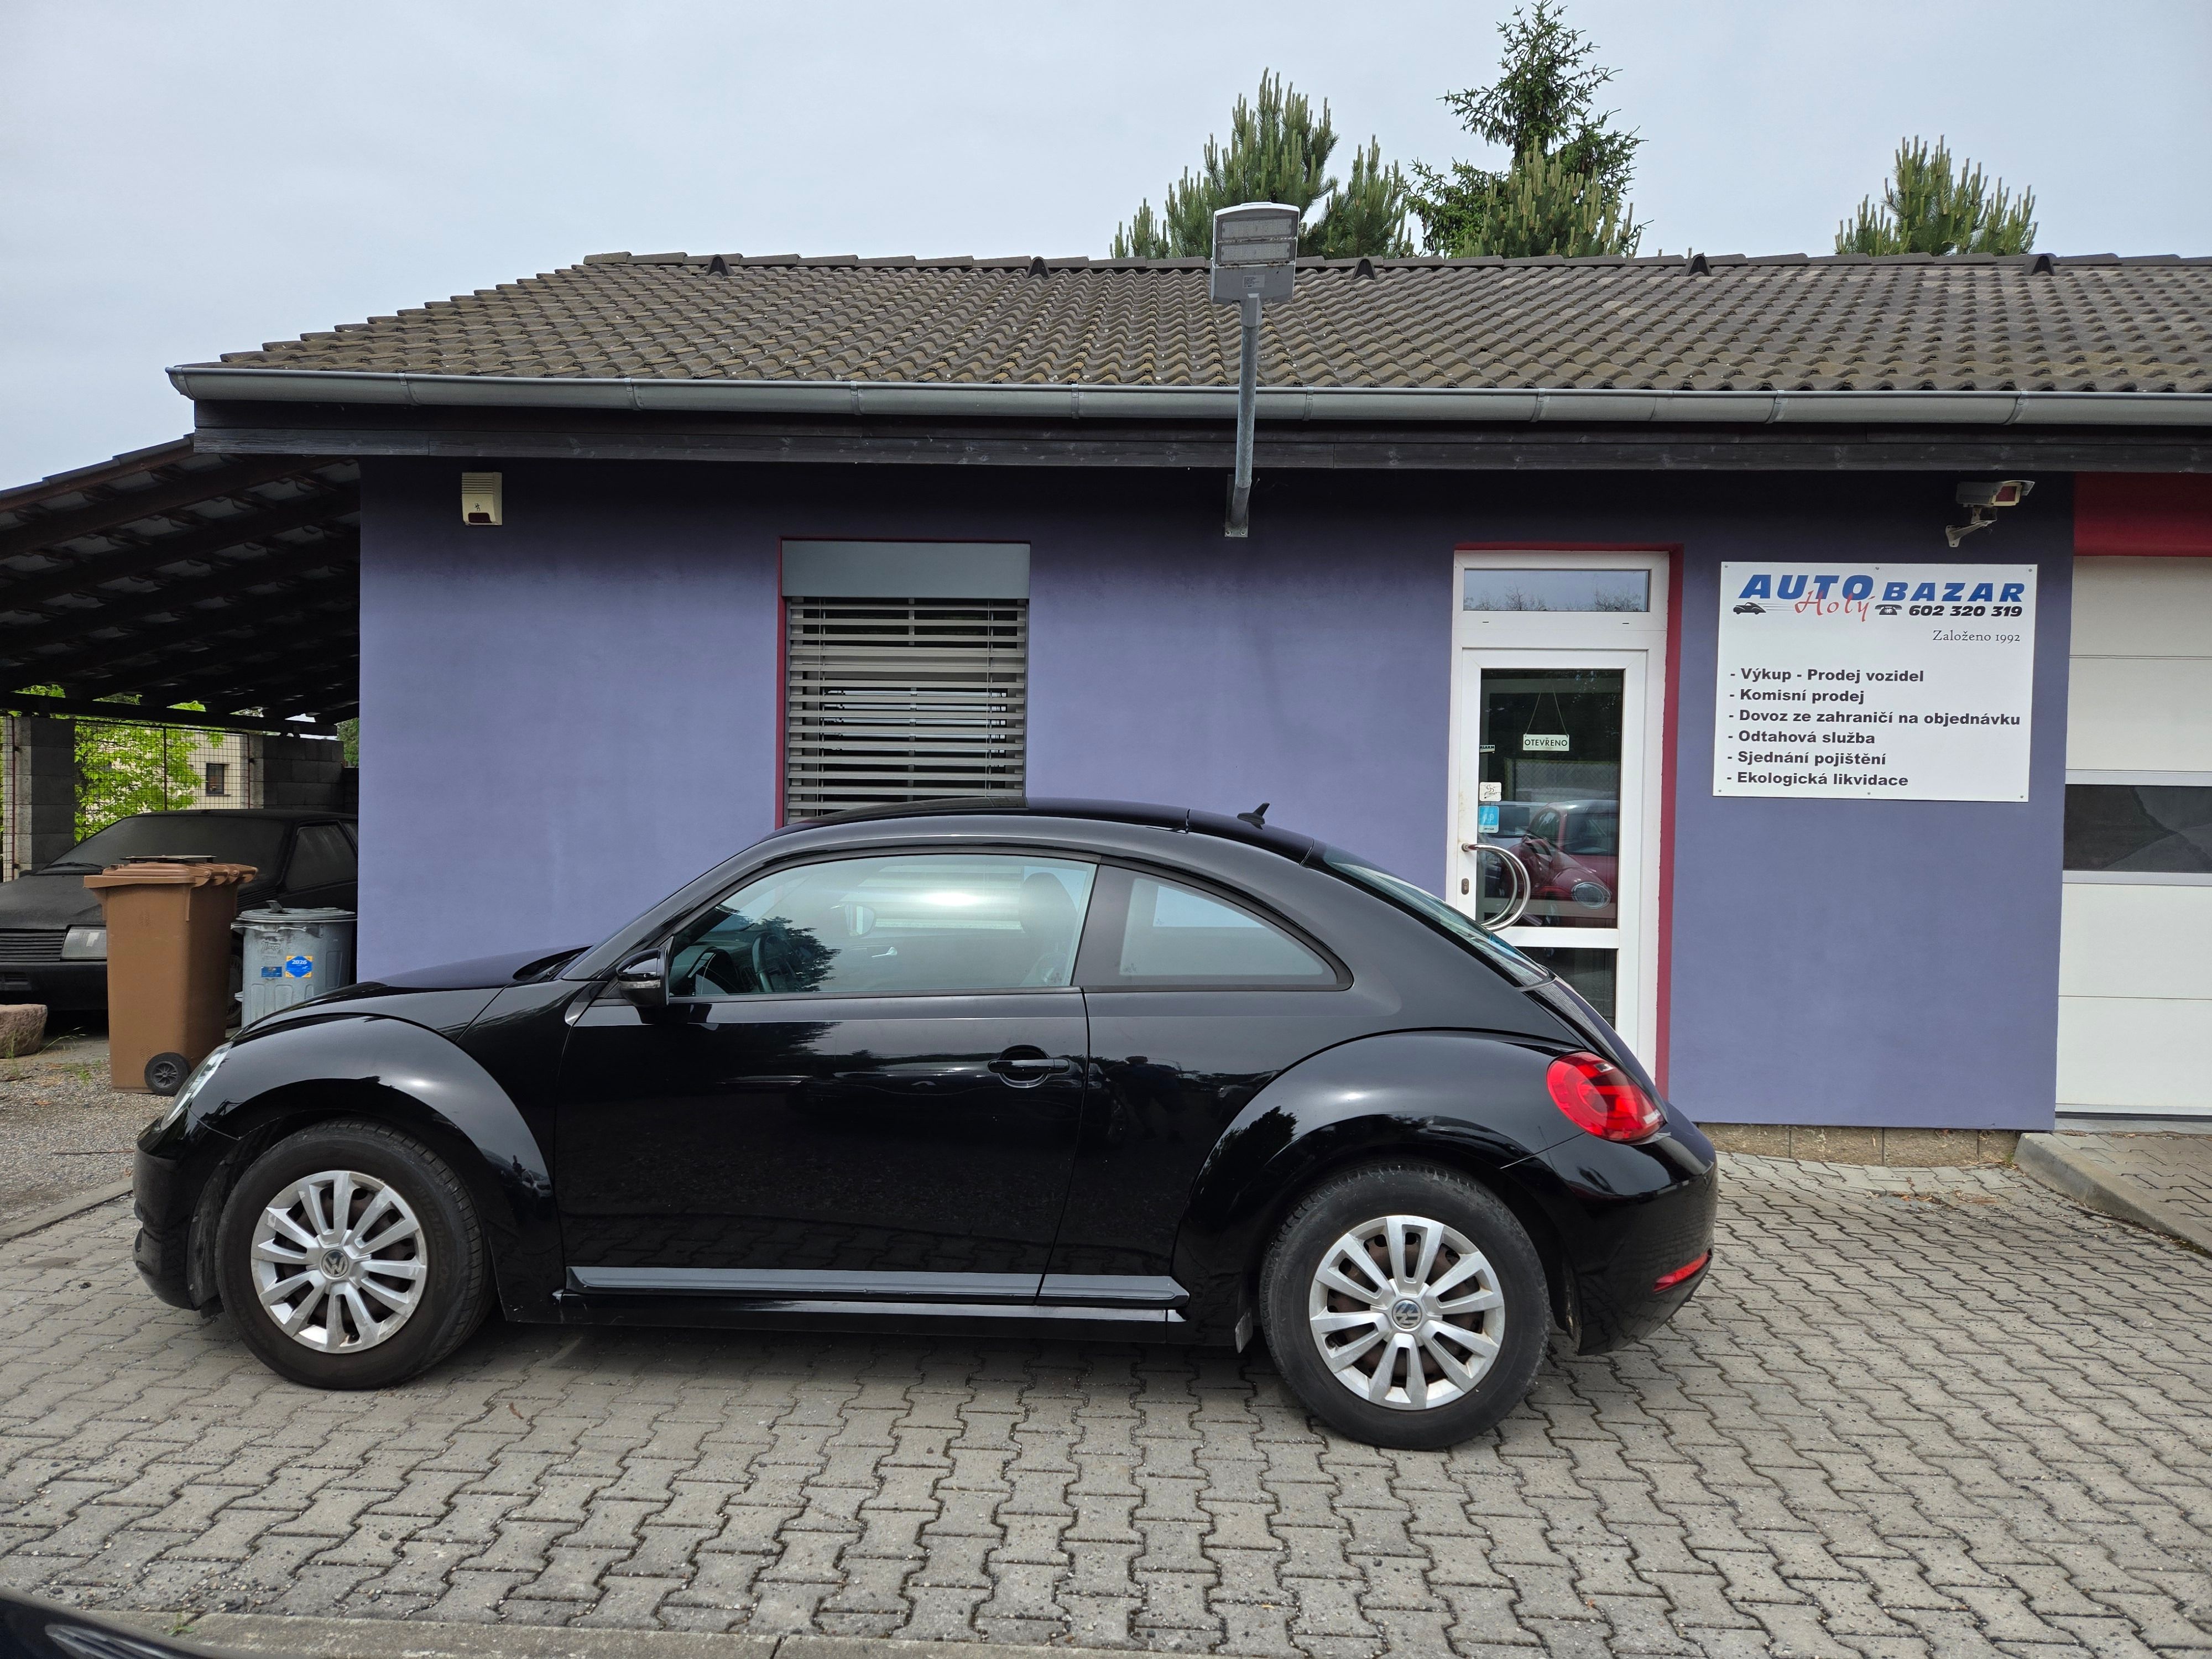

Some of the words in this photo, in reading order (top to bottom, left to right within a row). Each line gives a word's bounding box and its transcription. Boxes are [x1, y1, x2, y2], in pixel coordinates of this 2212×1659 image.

[1739, 574, 1874, 601] AUTO
[1882, 582, 2025, 602] BAZAR
[1794, 590, 1876, 622] Holý
[1908, 605, 1945, 617] 602
[1949, 606, 1986, 617] 320
[1990, 606, 2023, 617] 319
[1932, 629, 1991, 641] Založeno
[1995, 634, 2021, 644] 1992
[1740, 667, 1791, 683] Výkup
[1808, 669, 1860, 684] Prodej
[1866, 670, 1924, 682] vozidel
[1740, 688, 1807, 701] Komisní
[1812, 691, 1864, 705] prodej
[1739, 709, 1788, 722] Dovoz
[1793, 713, 1812, 722] ze
[1816, 711, 1893, 723] zahraničí
[1898, 714, 1918, 724] na
[1924, 712, 2020, 727] objednávku
[1525, 737, 1568, 747] OTEVŘENO
[1739, 730, 1817, 743] Odtahová
[1822, 732, 1875, 744] služba
[1738, 750, 1809, 765] Sjednání
[1814, 753, 1886, 767] pojištění
[1738, 771, 1827, 787] Ekologická
[1833, 773, 1908, 786] likvidace
